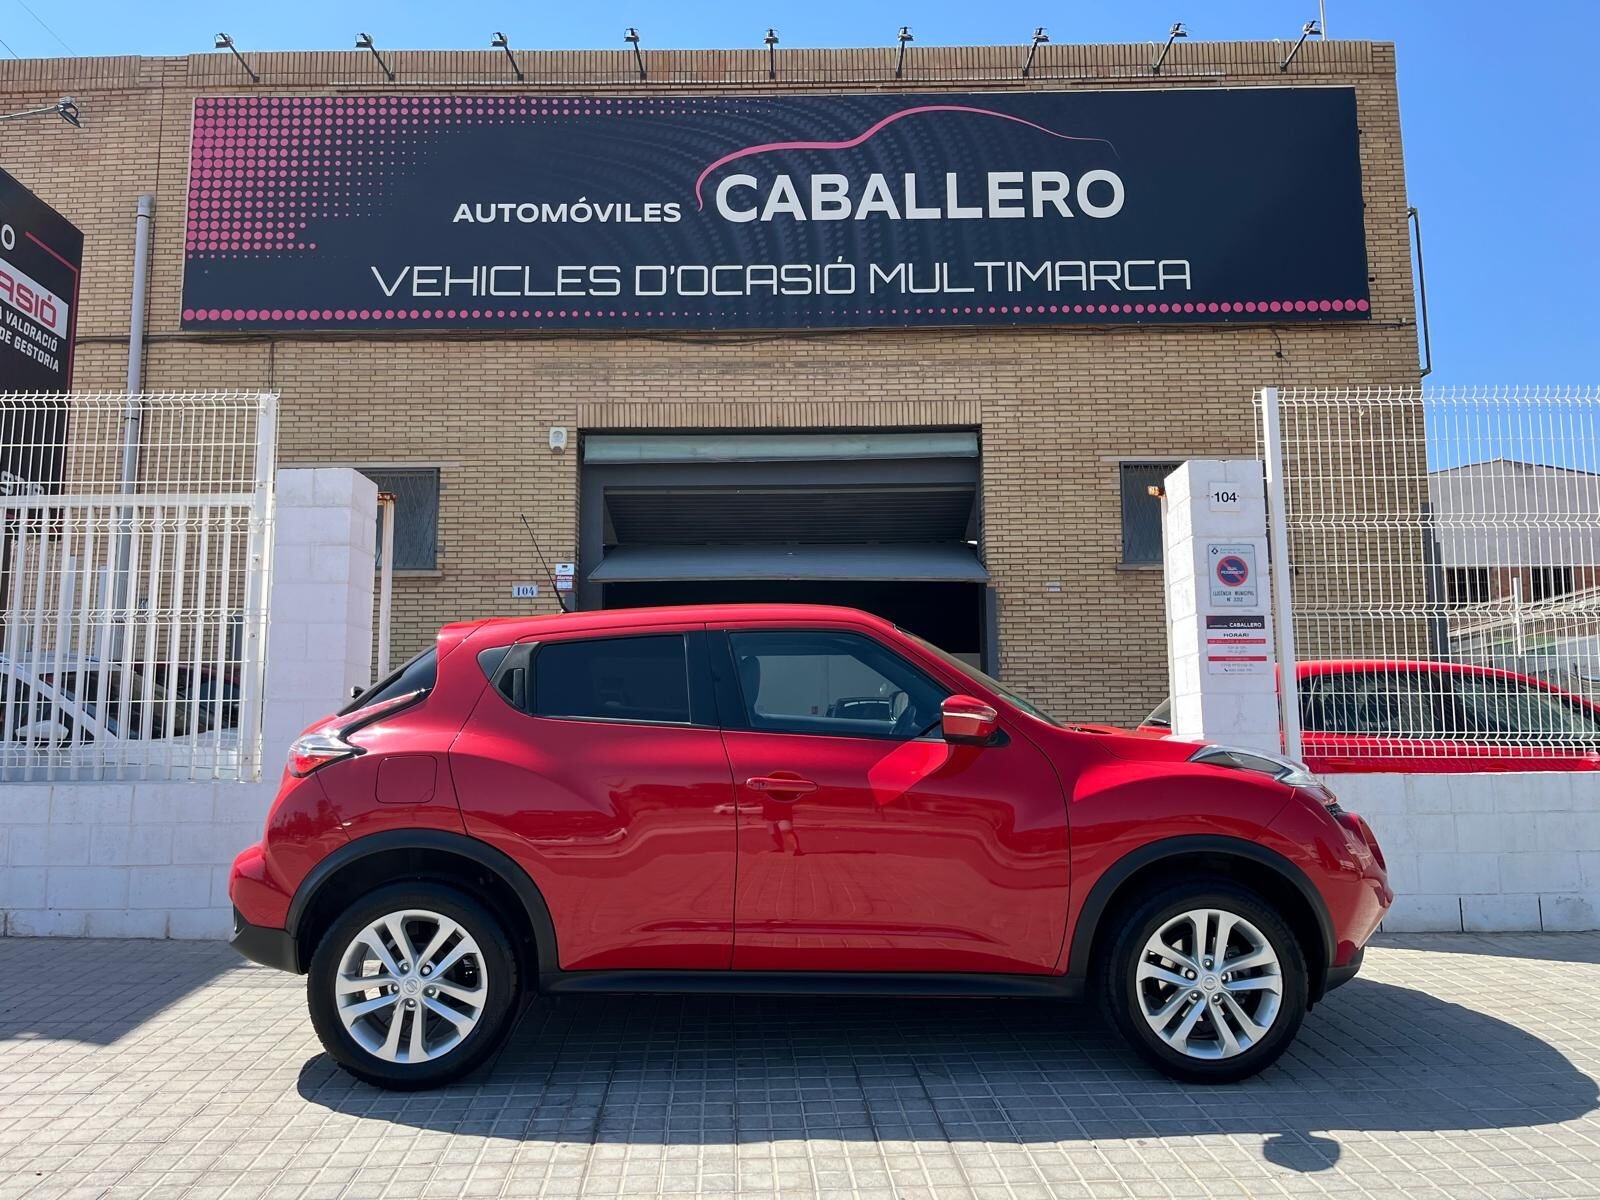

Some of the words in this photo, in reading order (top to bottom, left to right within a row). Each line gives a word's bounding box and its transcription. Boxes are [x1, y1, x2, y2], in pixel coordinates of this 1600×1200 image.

[453, 196, 682, 223] AUTOMÓVILES
[715, 169, 1125, 222] CABALLERO
[371, 265, 621, 297] VEHICLES
[635, 256, 856, 297] D'OCASIÓ
[869, 259, 1192, 294] MULTIMARCA
[6, 310, 58, 352] VALORACIÓ
[14, 335, 59, 373] GESTORIA
[1214, 491, 1238, 503] 104
[517, 586, 534, 596] 104
